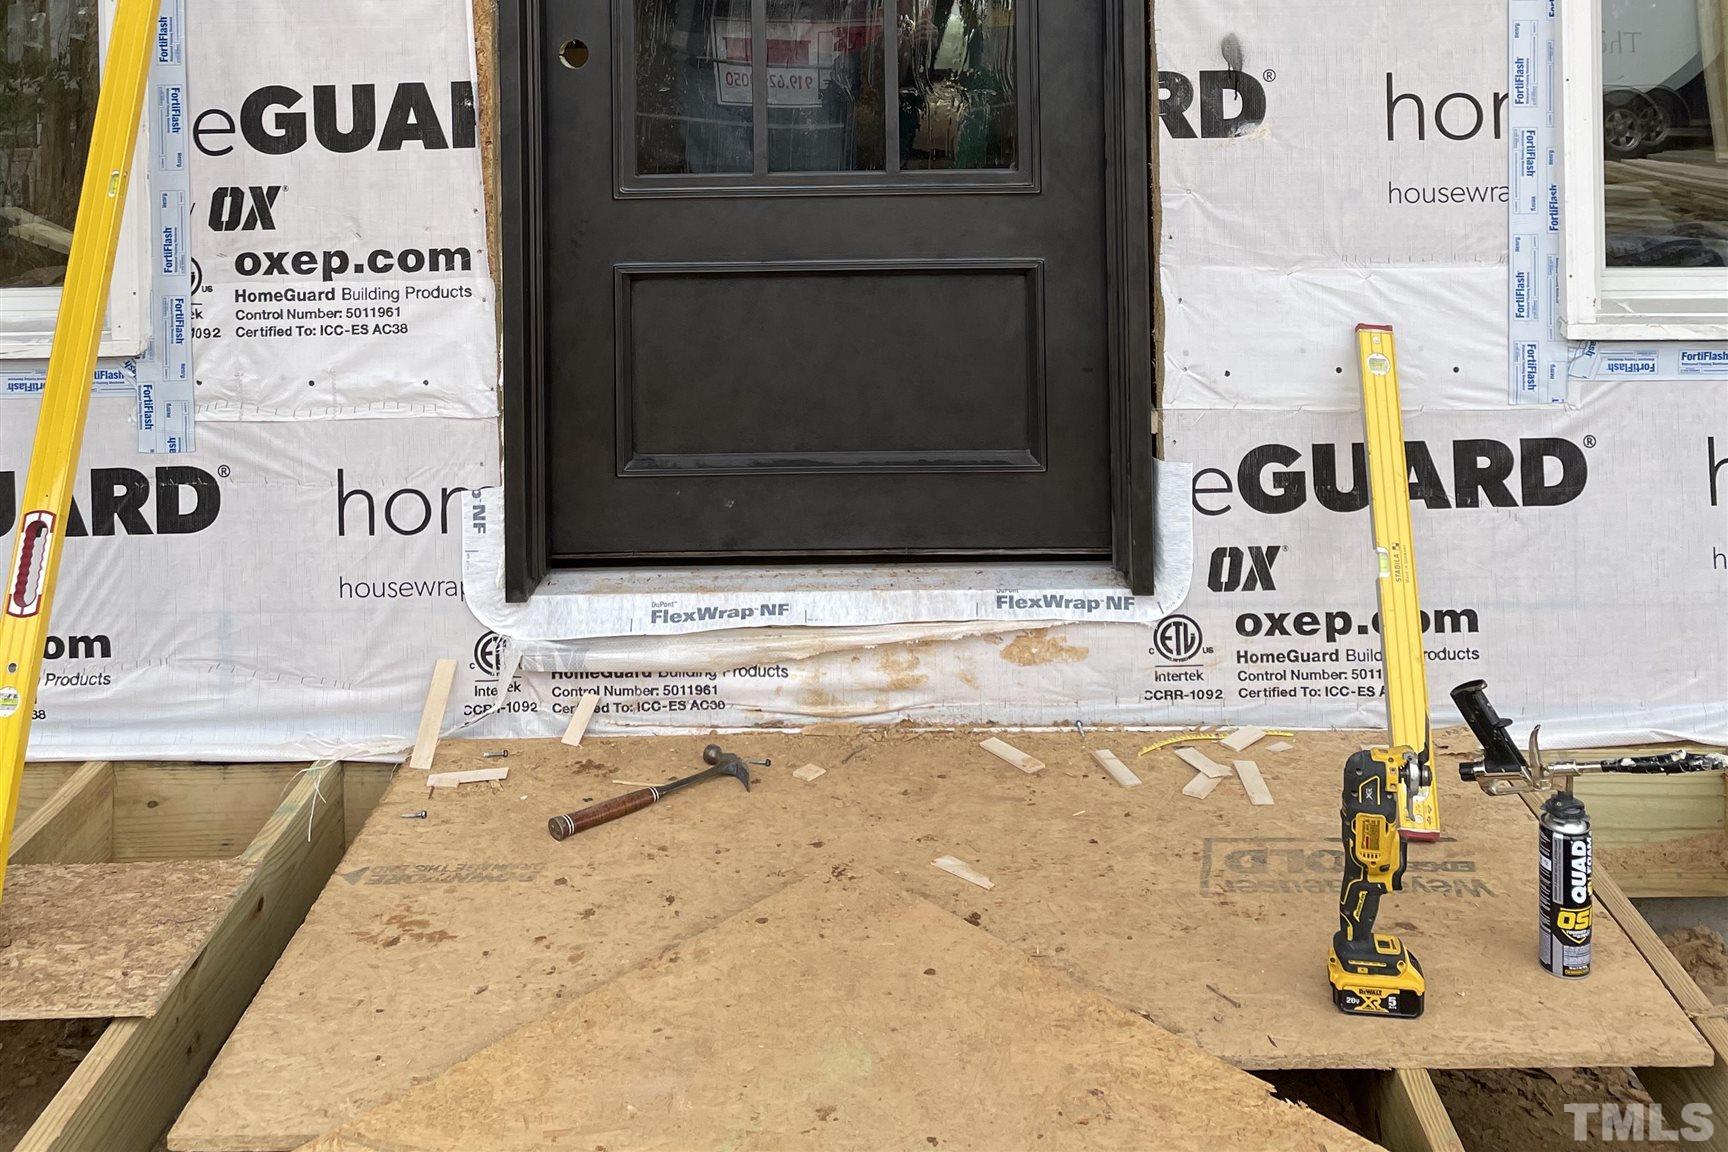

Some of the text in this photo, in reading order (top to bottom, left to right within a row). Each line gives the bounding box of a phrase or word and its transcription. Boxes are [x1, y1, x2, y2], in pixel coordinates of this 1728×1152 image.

[1515, 58, 1524, 105] FortiFlash
[171, 87, 180, 134] FortiFlash
[1526, 130, 1536, 177] FortiFlash
[208, 186, 281, 232] OX
[1550, 184, 1559, 231] FortiFlash
[164, 227, 173, 273] FortiFlash
[234, 247, 472, 282] oxep.com
[234, 285, 473, 303] HomeGuard Building Products
[1516, 271, 1525, 318] FortiFlash
[175, 298, 184, 344] FortiFlash
[235, 307, 401, 321] Control Number: 5011961
[235, 323, 409, 338] Certified To: ICC-ES AC38
[1528, 344, 1537, 391] FortiFlash
[1608, 362, 1655, 373] FortiFlash
[143, 384, 153, 430] FortiFlash
[1207, 546, 1281, 592] OX
[651, 603, 789, 623] FlexWrap NF
[996, 595, 1135, 612] FlexWrap NF
[1237, 649, 1339, 664] HomeGuard
[45, 673, 111, 686] Products
[1155, 670, 1204, 682] Intertek
[1238, 670, 1286, 682] Control
[1291, 669, 1347, 681] Number:
[552, 684, 718, 697] Control Number: 5011961
[1238, 687, 1296, 699] Certified
[1301, 686, 1321, 698] To:
[1325, 685, 1375, 697] ICC-ES
[613, 702, 634, 713] To:
[638, 701, 686, 712] ICC-ES
[1571, 841, 1587, 904] QUAD
